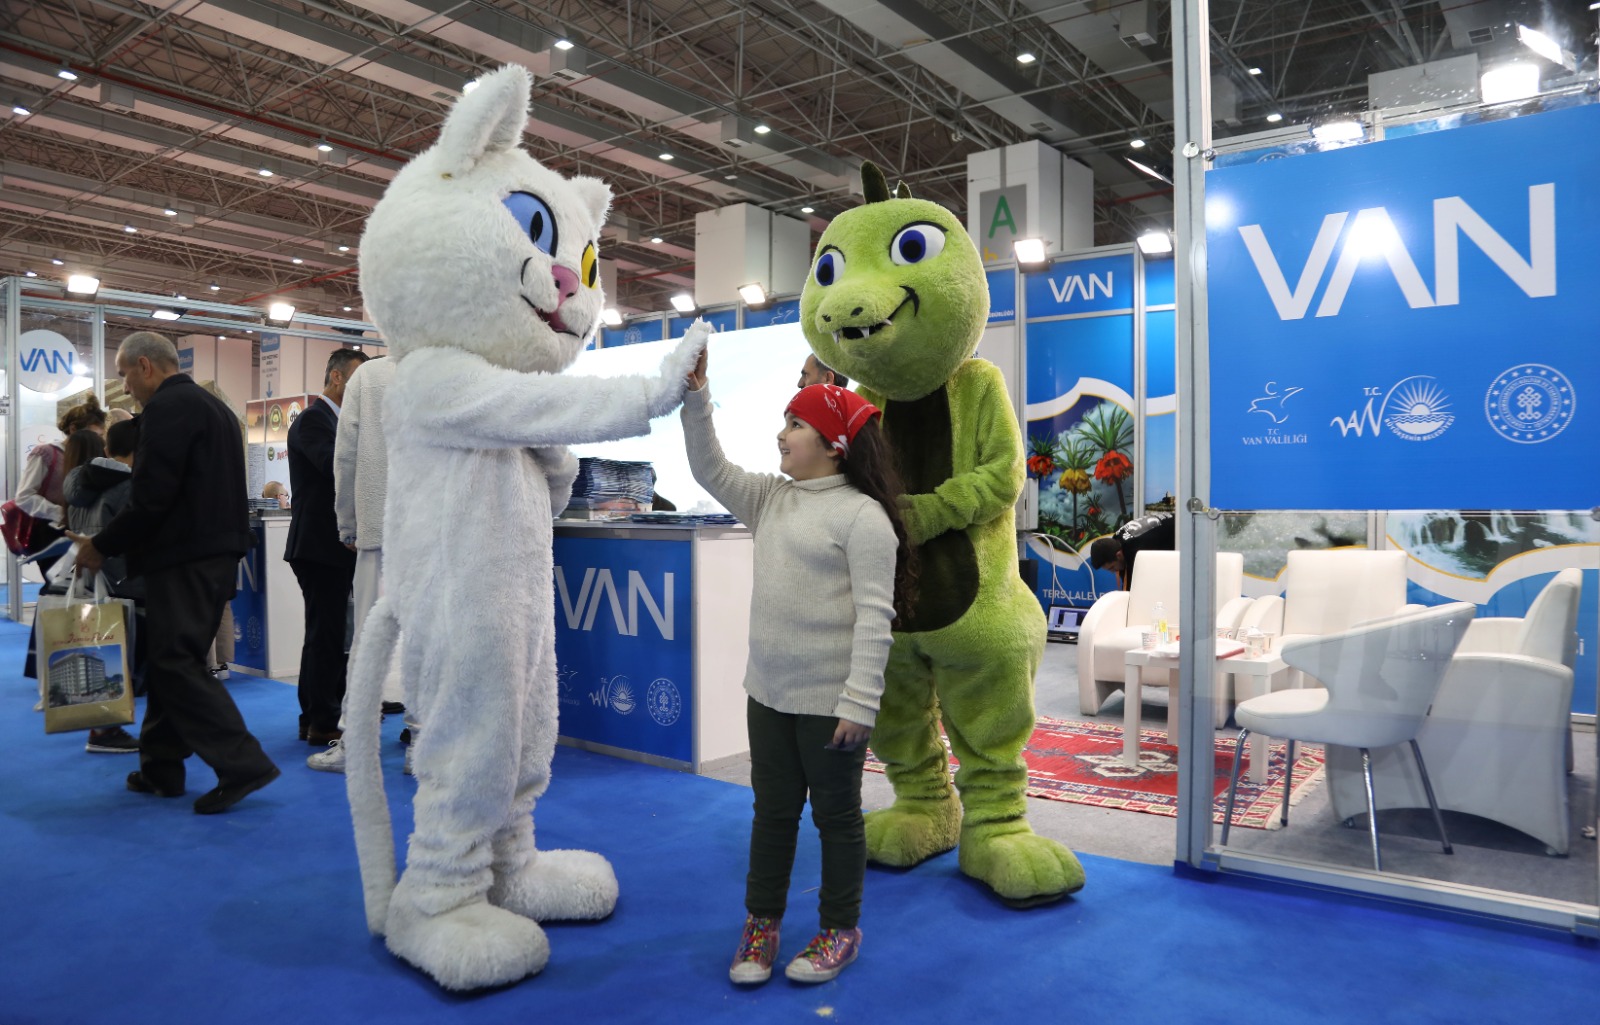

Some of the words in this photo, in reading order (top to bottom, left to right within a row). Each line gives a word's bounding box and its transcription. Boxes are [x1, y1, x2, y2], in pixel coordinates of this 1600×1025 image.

[988, 194, 1017, 239] A
[1238, 182, 1556, 320] VAN
[1048, 271, 1113, 303] VAN
[20, 348, 73, 375] VAN
[1363, 387, 1382, 396] T.C.
[1242, 437, 1262, 446] VAN
[553, 565, 675, 641] VAN
[1042, 588, 1067, 599] TERS
